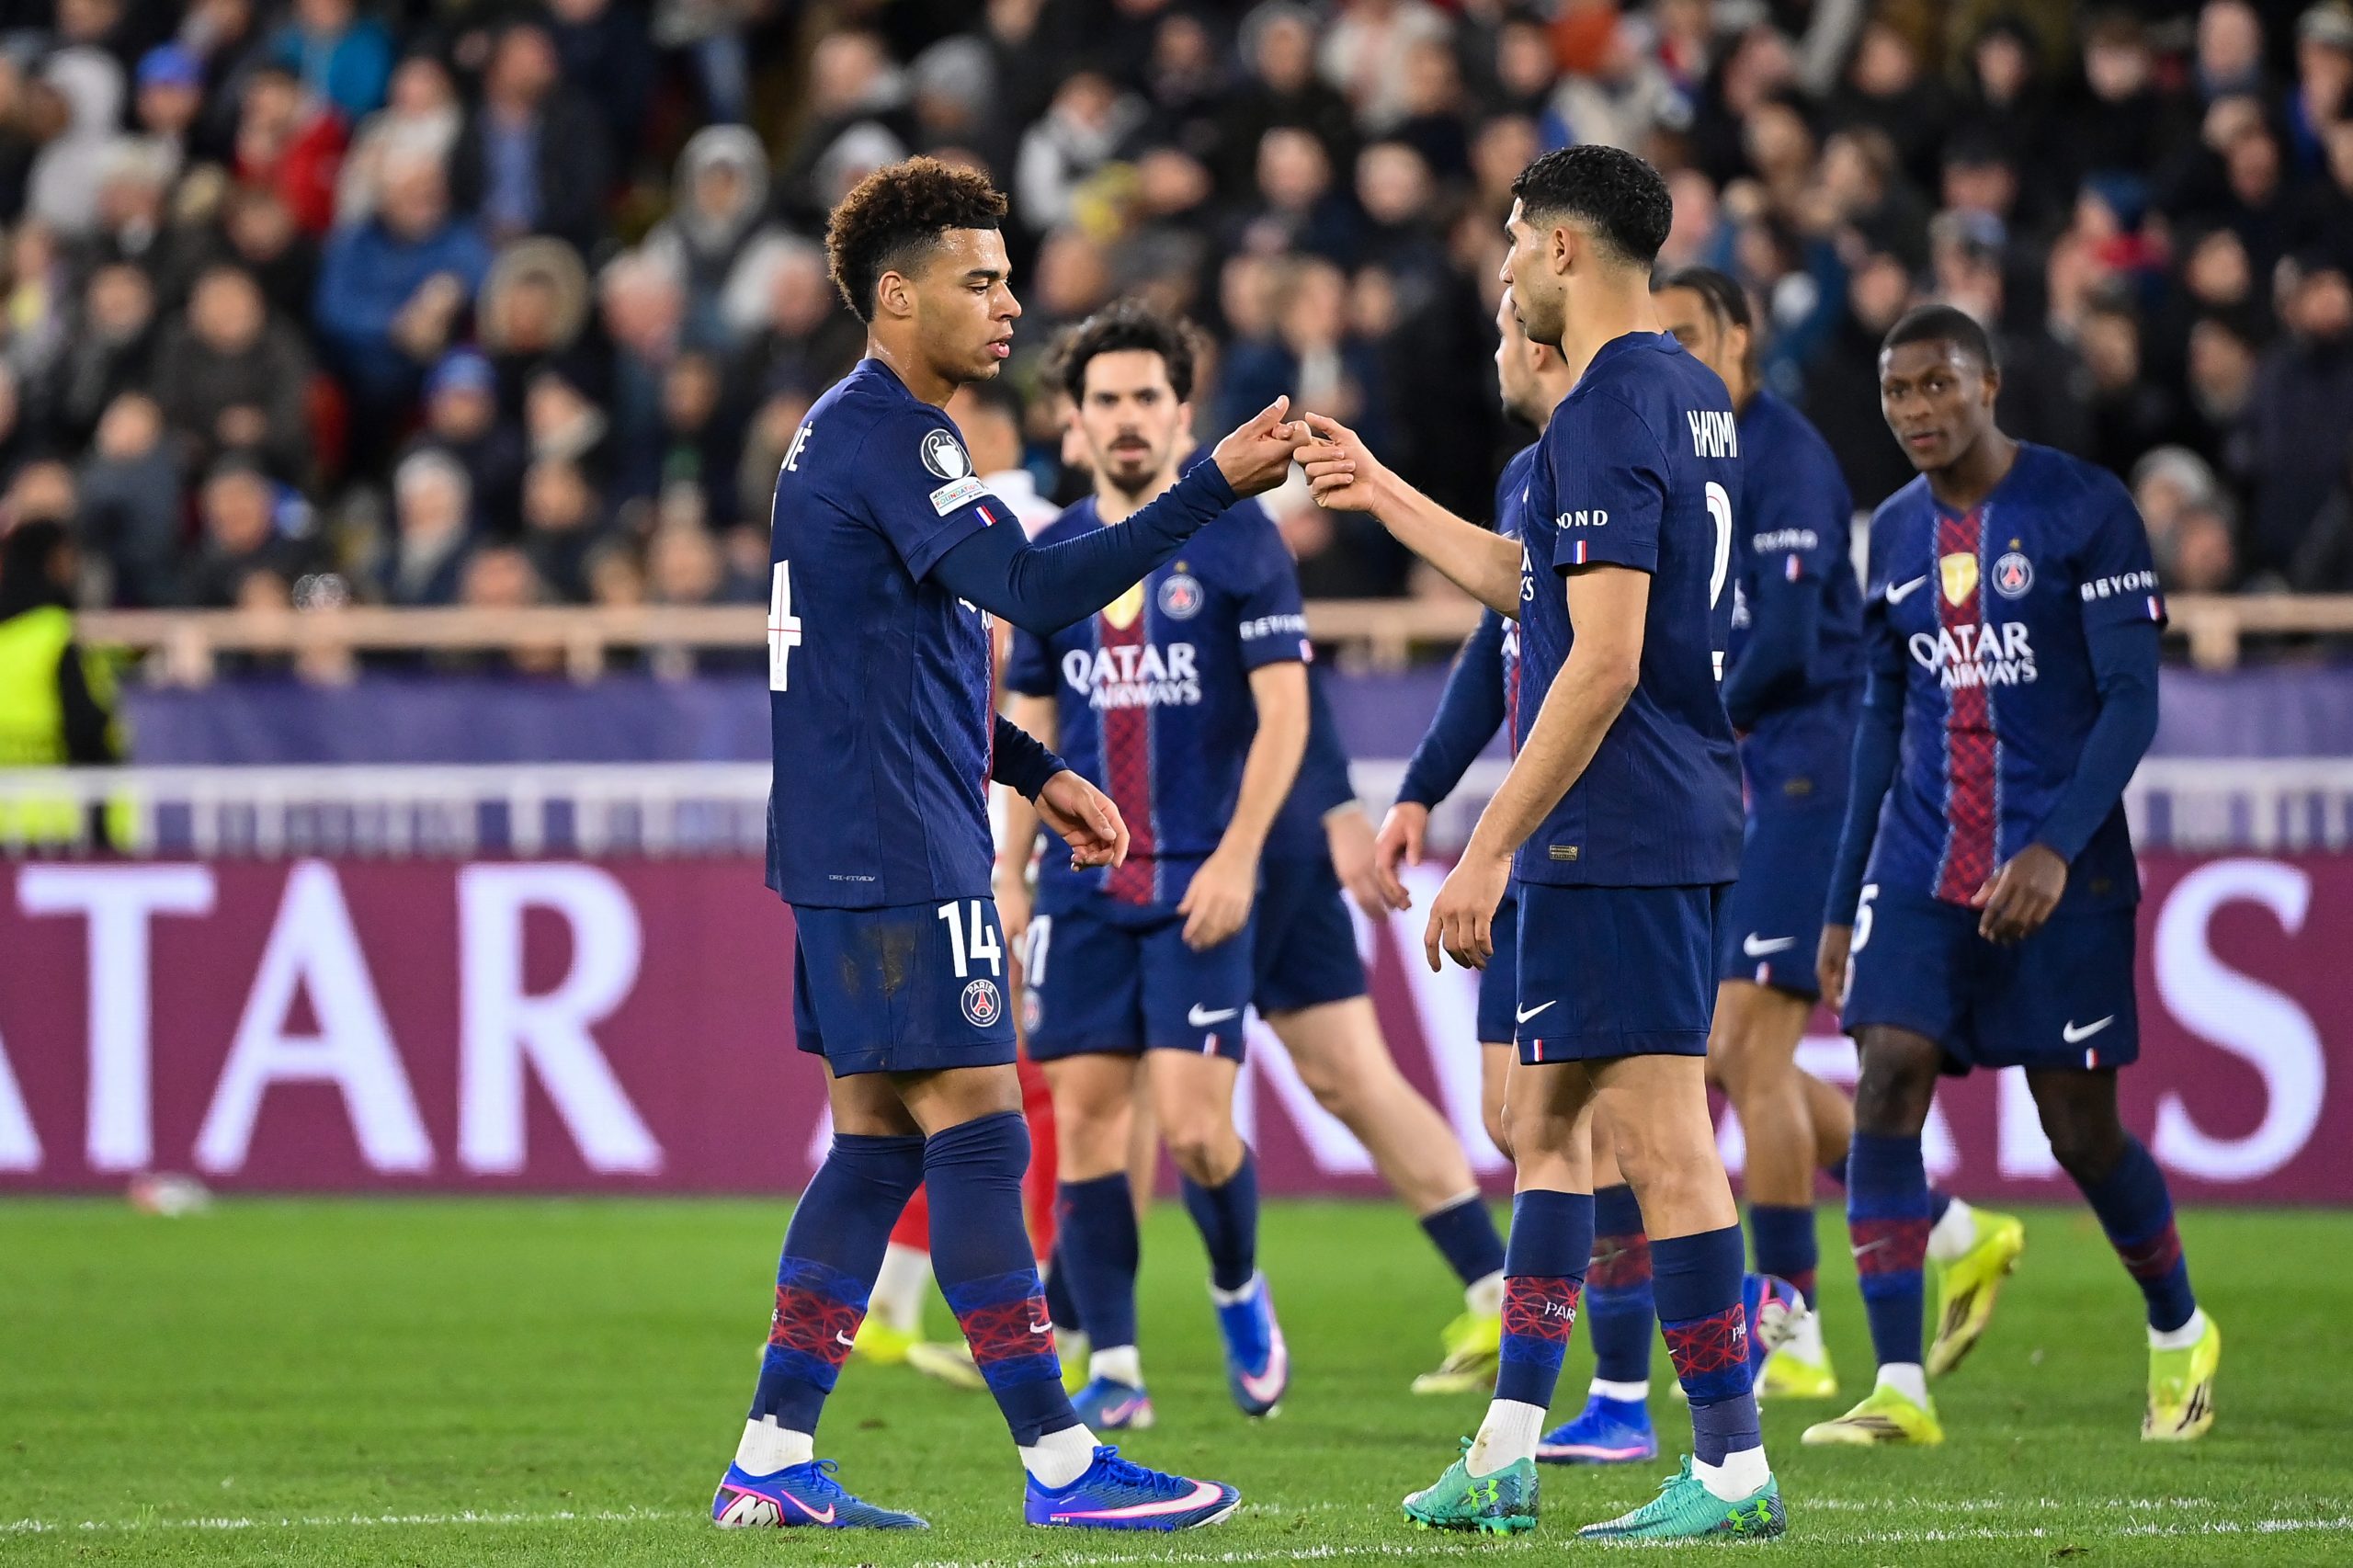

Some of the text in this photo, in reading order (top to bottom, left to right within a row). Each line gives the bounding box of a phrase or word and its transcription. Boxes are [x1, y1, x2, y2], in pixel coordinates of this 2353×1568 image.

[780, 420, 813, 472] UÉ
[2080, 570, 2159, 603] BEYON
[767, 560, 801, 692] 4
[1908, 621, 2034, 676] QATAR
[1062, 642, 1199, 696] QATAR
[1087, 677, 1202, 710] AIRWAYS
[1939, 656, 2038, 689] AIRWAYS
[938, 900, 1002, 978] 14
[1849, 883, 1880, 954] 5
[967, 982, 994, 994] PARIS
[0, 858, 665, 1173] TAR
[1544, 1301, 1577, 1323] PAR
